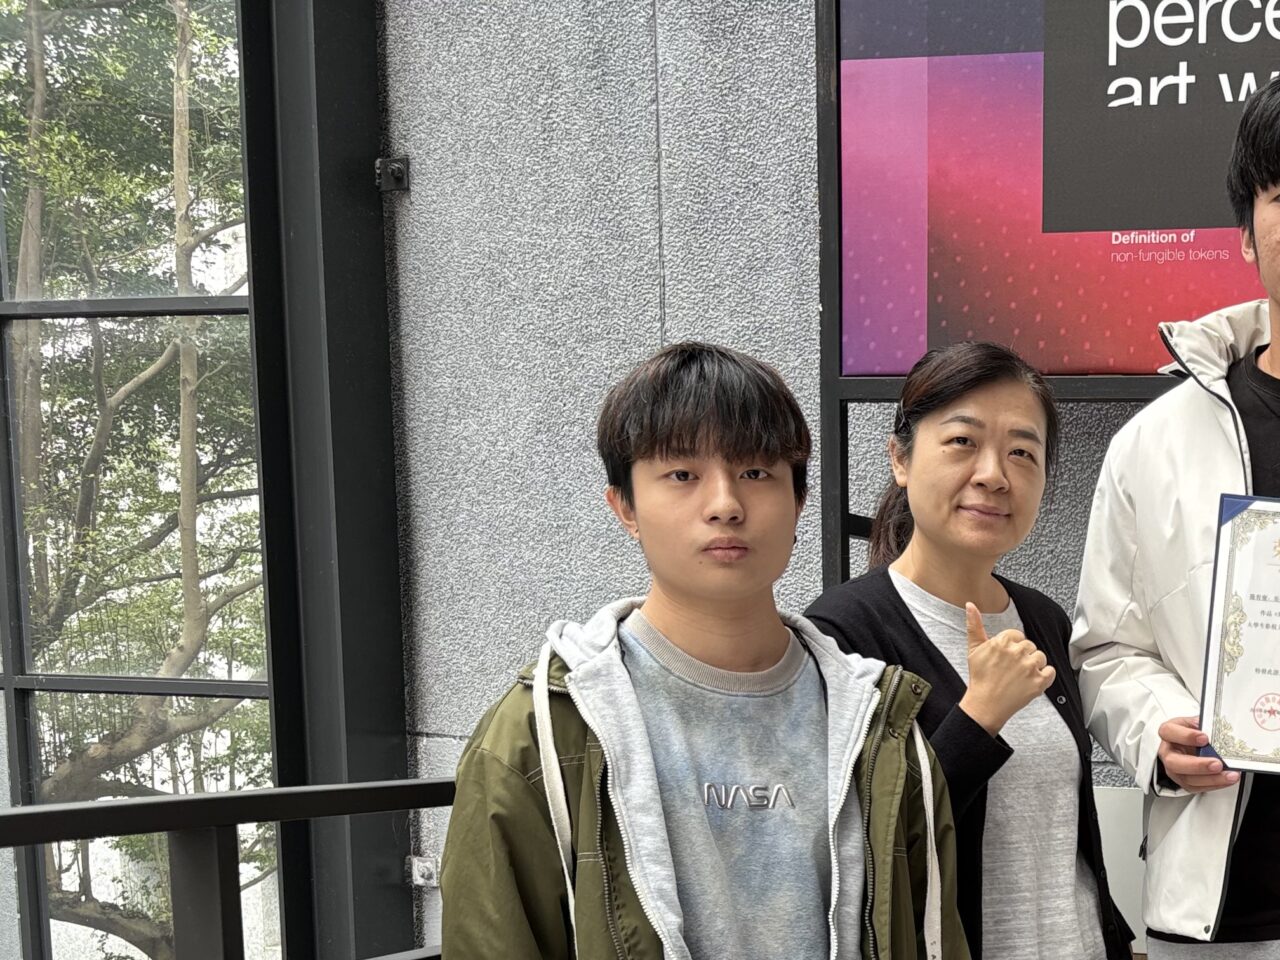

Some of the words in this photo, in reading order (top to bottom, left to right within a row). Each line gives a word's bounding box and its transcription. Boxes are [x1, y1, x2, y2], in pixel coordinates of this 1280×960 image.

[1106, 61, 1196, 108] art
[1111, 230, 1177, 244] Definition
[1181, 229, 1196, 243] of
[1111, 249, 1185, 264] non-fungible
[1189, 248, 1230, 260] tokens
[704, 782, 796, 810] NASA
